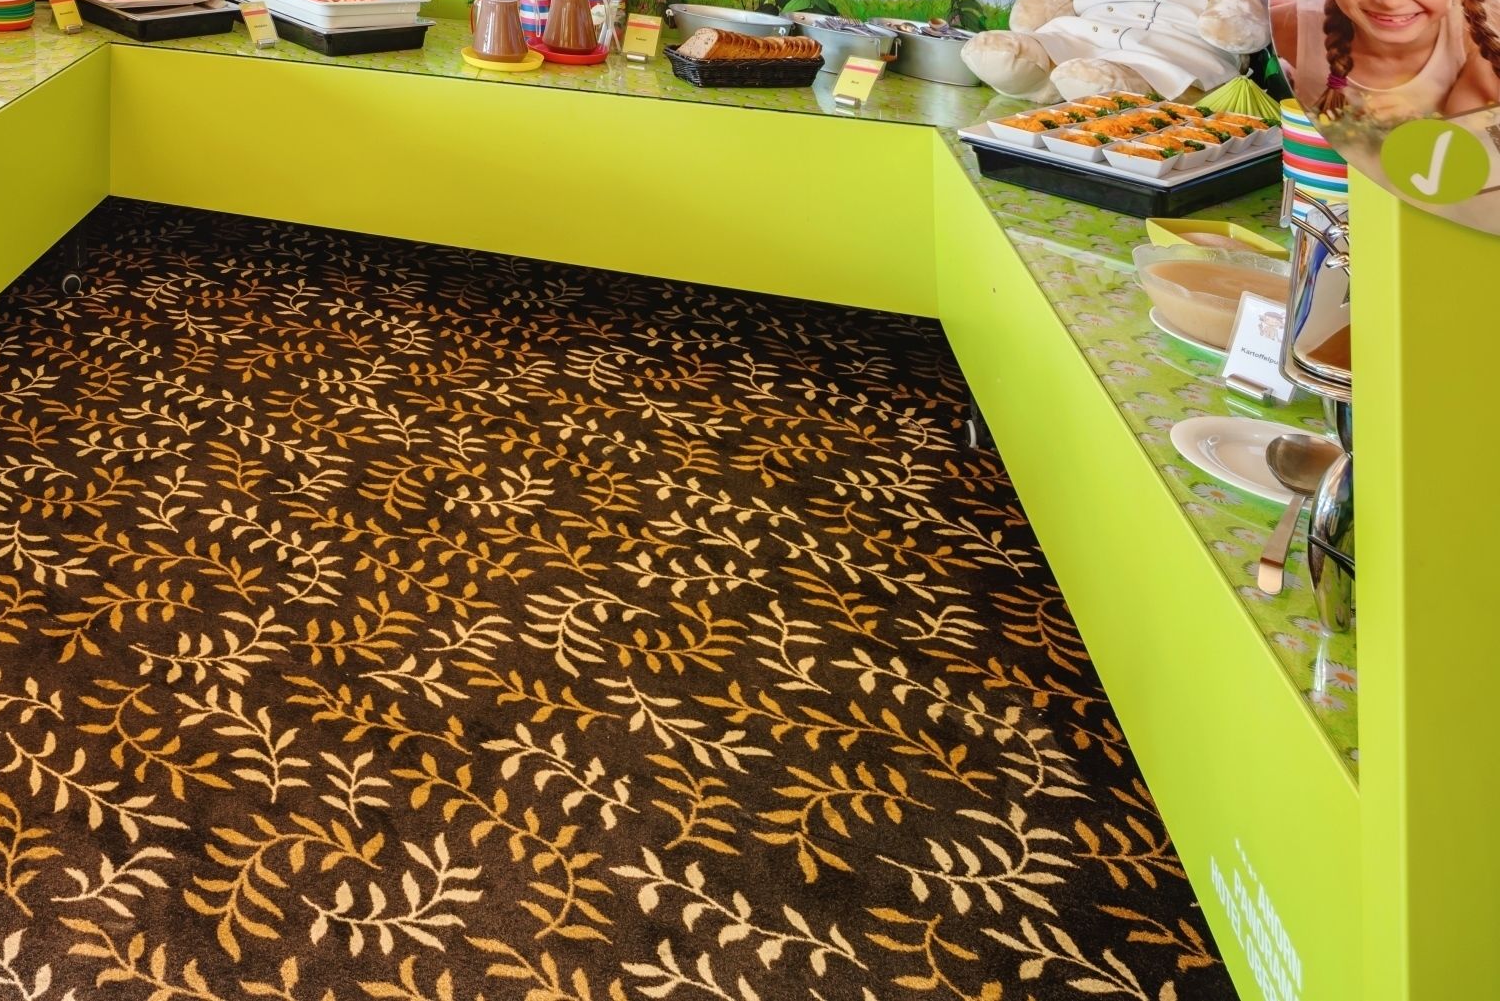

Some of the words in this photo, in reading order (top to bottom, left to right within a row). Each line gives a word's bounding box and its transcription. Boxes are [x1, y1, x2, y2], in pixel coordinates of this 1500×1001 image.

[1241, 347, 1278, 365] Kartoffelpu
[1210, 855, 1246, 952] HOTEL
[1258, 882, 1303, 994] AHORN
